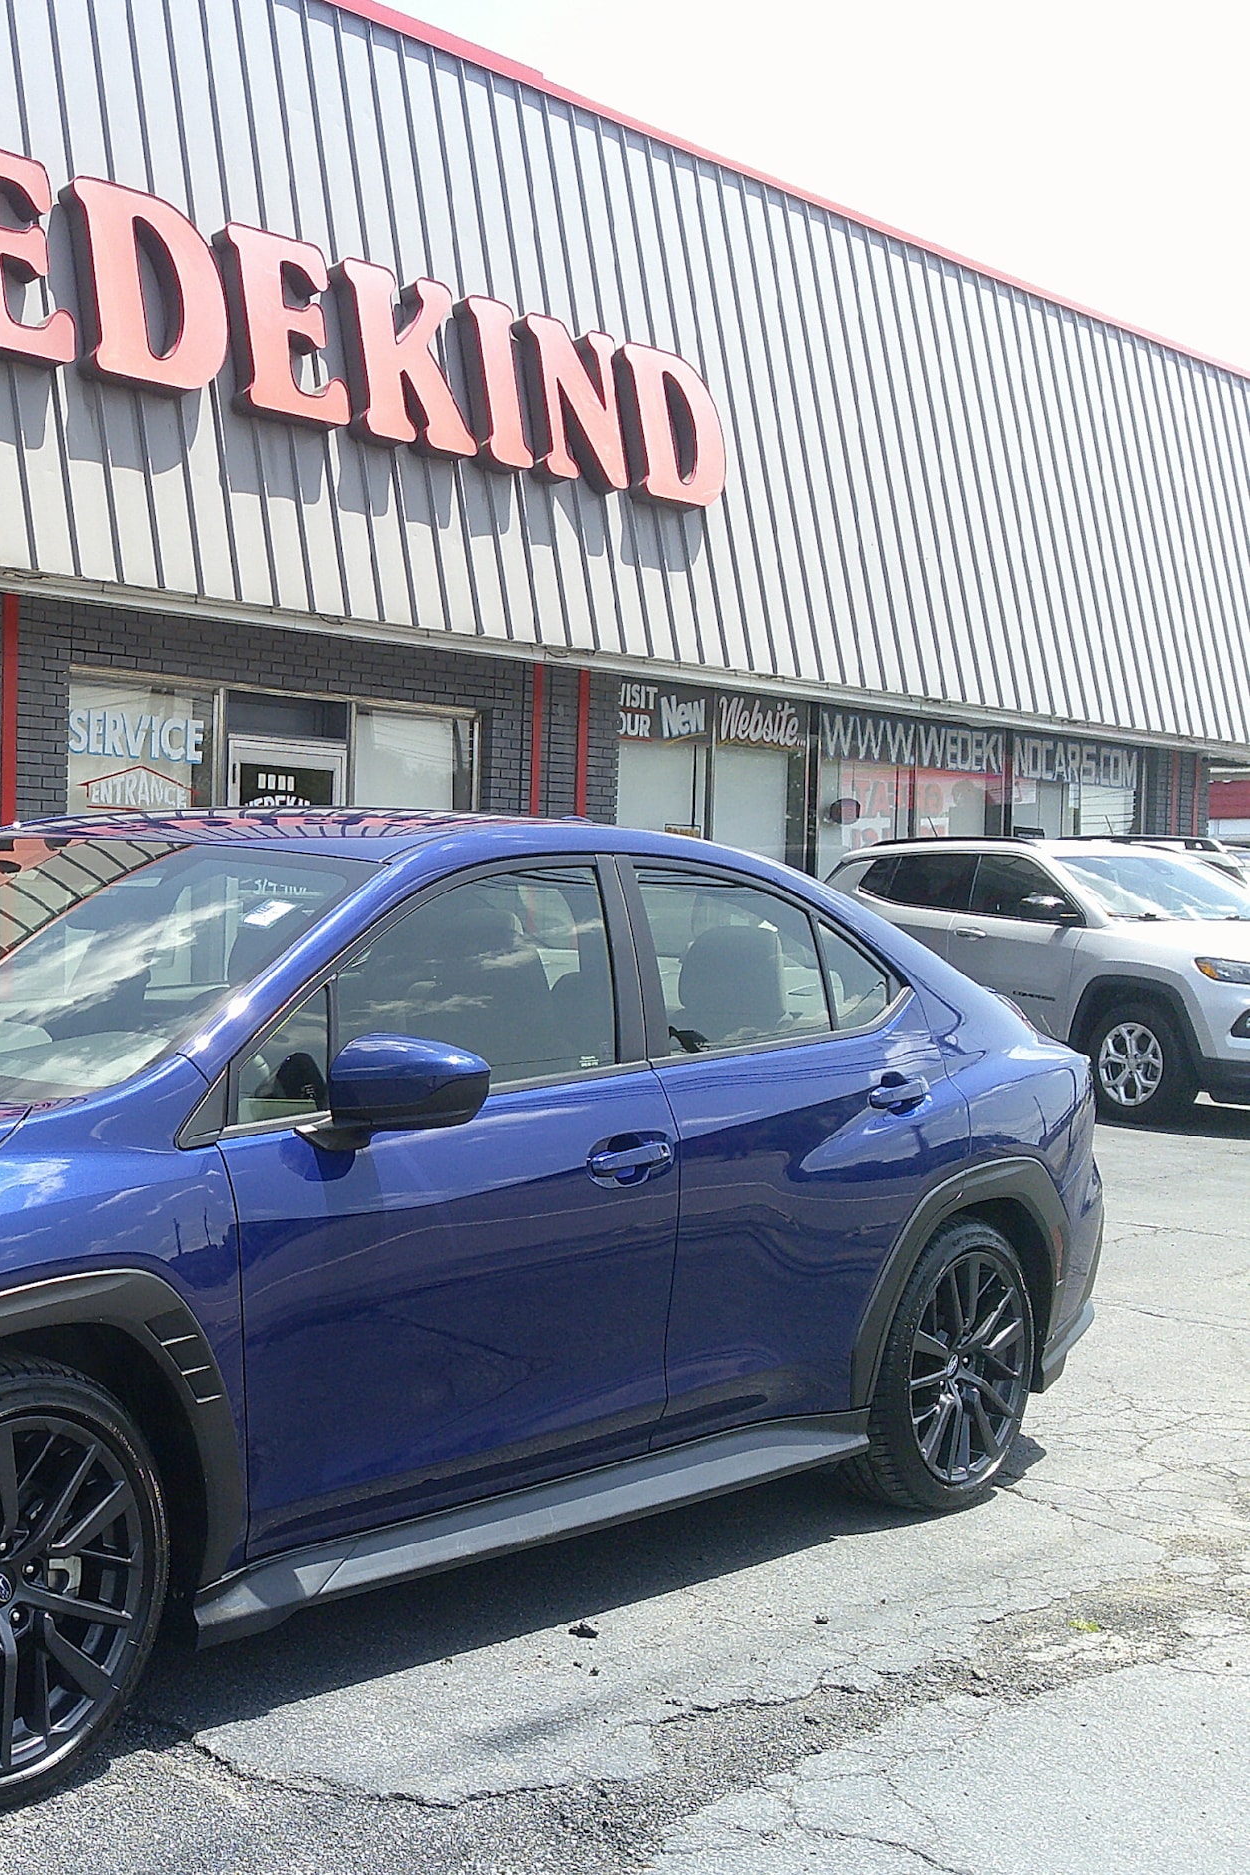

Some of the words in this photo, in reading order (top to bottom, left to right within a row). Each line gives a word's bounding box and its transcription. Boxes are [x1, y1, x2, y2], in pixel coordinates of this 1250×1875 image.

[68, 708, 205, 764] SERVICE
[661, 694, 706, 739] New
[90, 770, 188, 809] ENTRANCE
